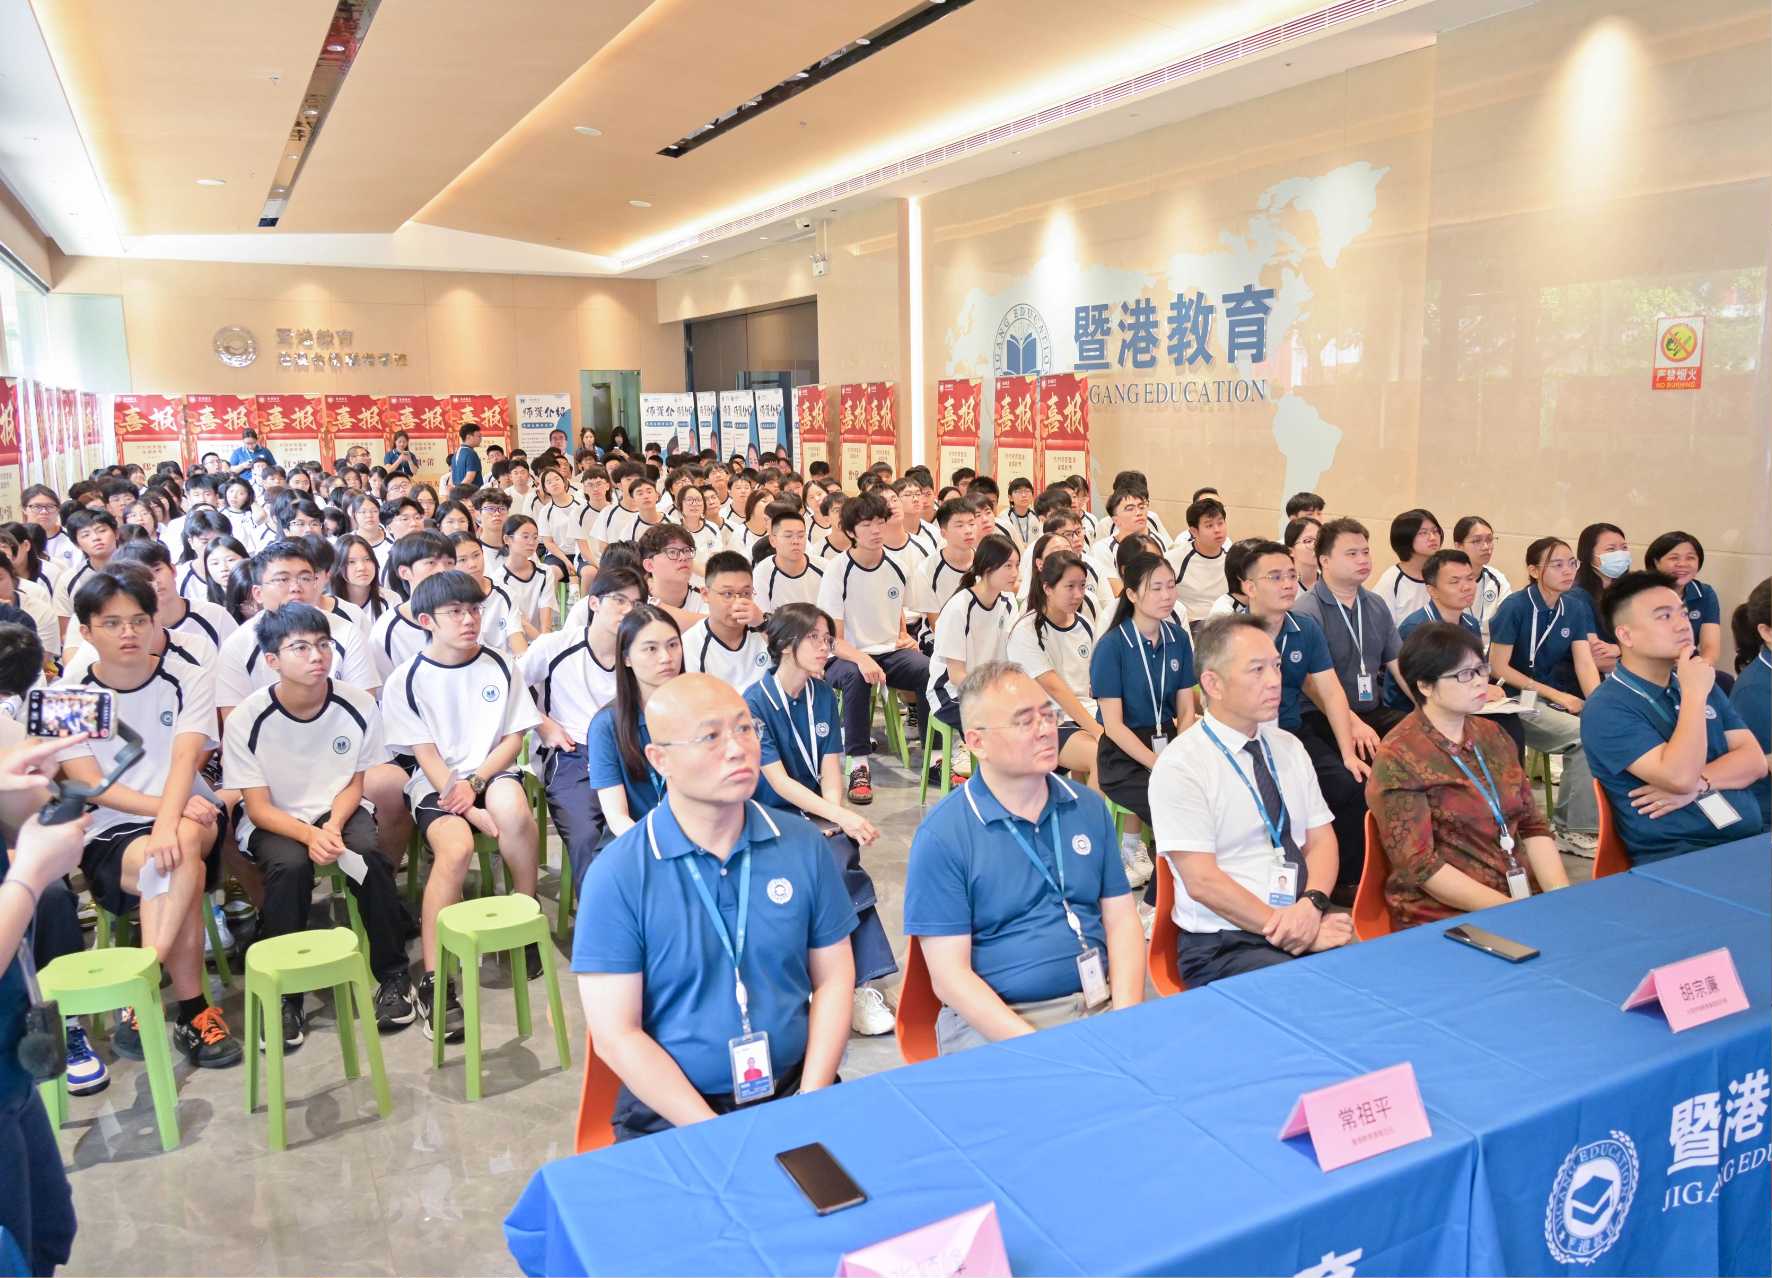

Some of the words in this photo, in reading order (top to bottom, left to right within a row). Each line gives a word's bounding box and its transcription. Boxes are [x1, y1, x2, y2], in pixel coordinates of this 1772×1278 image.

[1074, 284, 1276, 372] 暨港教育
[1656, 368, 1697, 381] 严禁烟火
[1145, 379, 1267, 405] EDUCATION
[121, 405, 178, 432] 喜报
[194, 404, 249, 431] 喜报
[264, 404, 317, 431] 喜报
[332, 405, 383, 431] 喜报
[396, 405, 446, 431] 喜报
[801, 398, 826, 431] 喜报
[841, 398, 867, 432] 喜报
[868, 395, 895, 432] 喜报
[940, 394, 977, 433] 喜报
[997, 391, 1035, 433] 喜报
[1043, 390, 1088, 433] 喜报
[1338, 1096, 1392, 1131] 常祖平
[1666, 1068, 1771, 1176] 暨港
